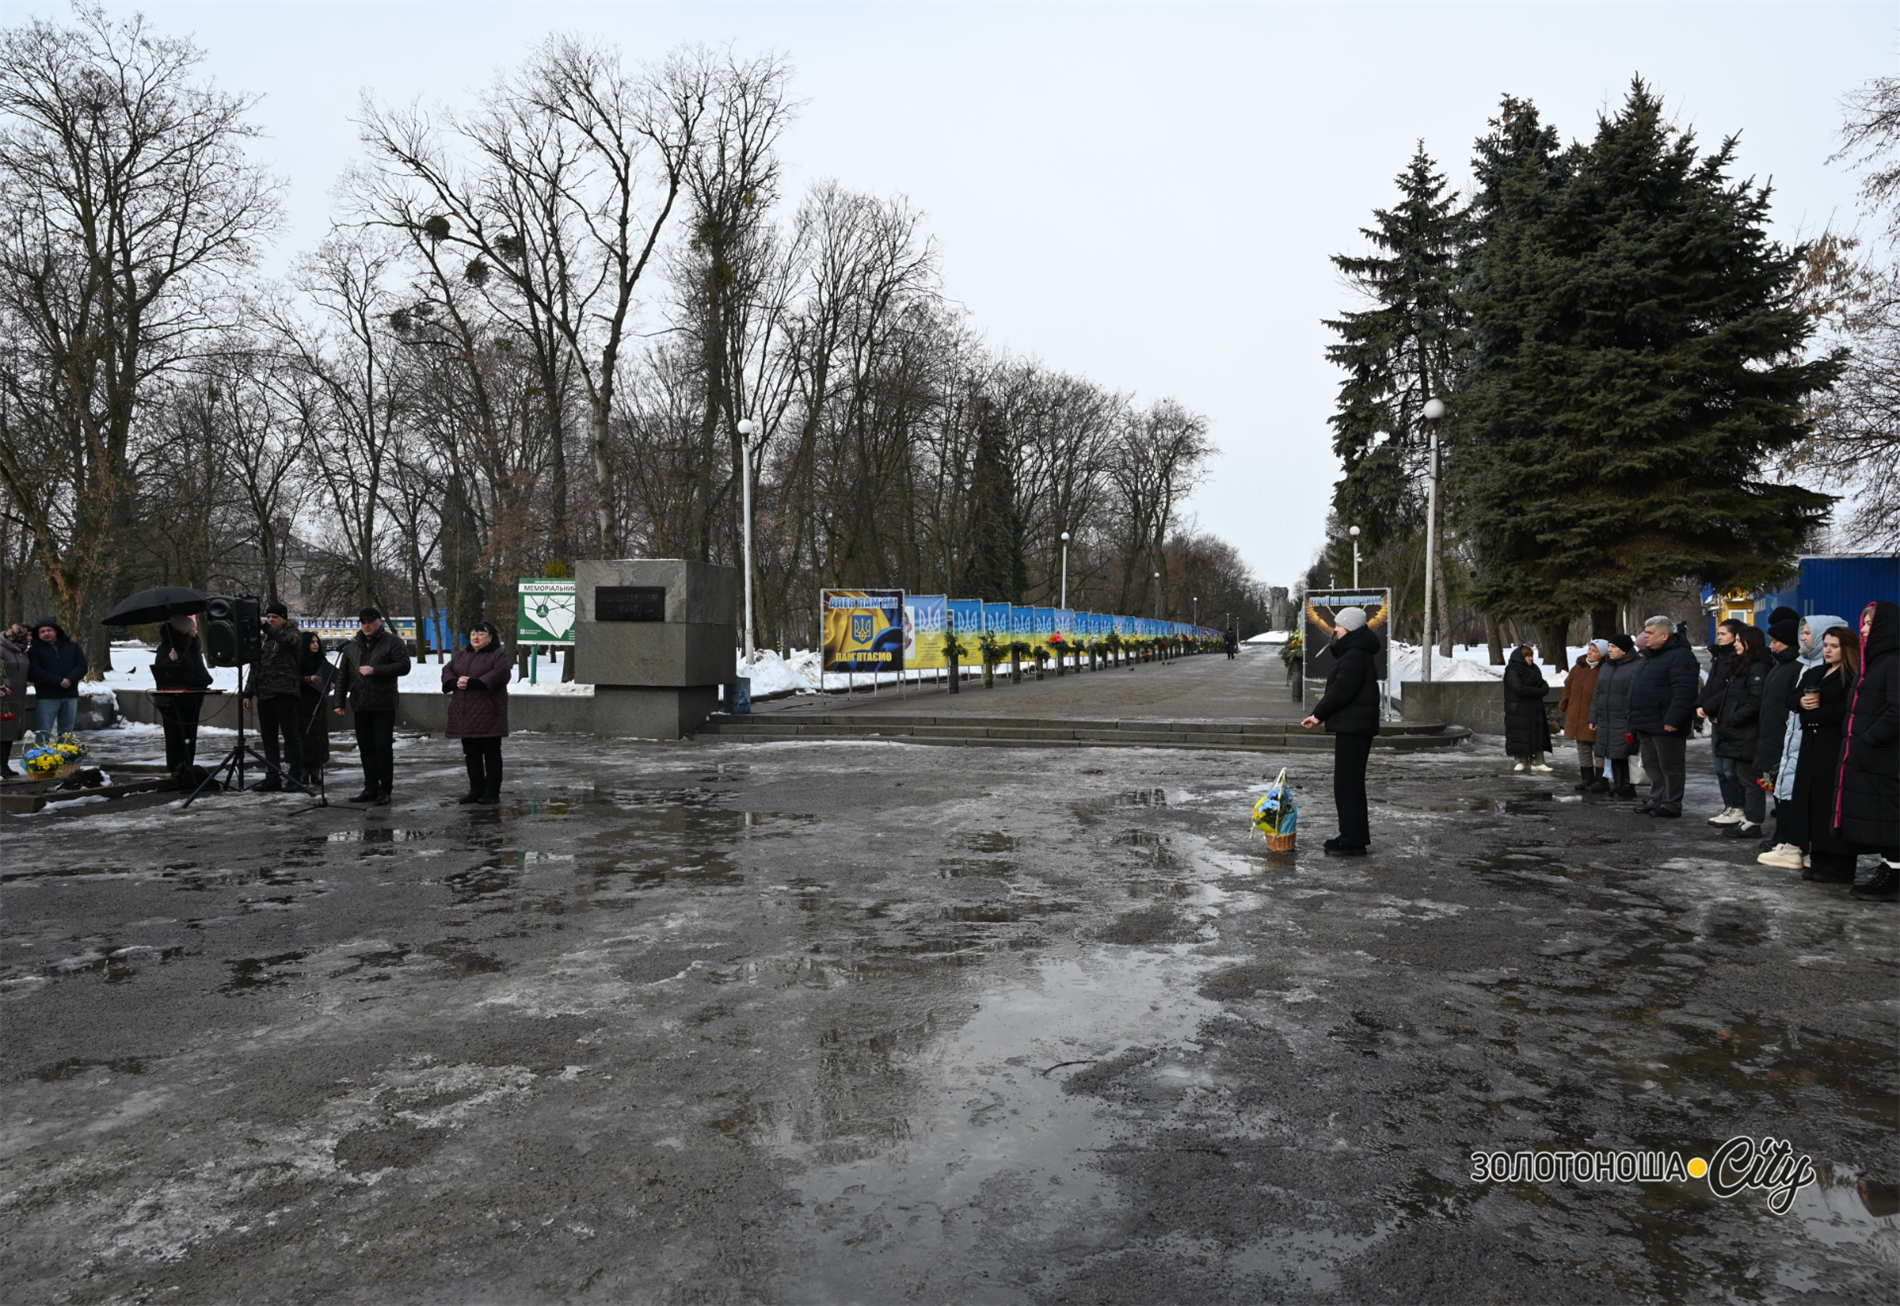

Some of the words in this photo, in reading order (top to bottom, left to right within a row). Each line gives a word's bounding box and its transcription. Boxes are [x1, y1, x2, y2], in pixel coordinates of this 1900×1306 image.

[829, 597, 857, 609] АЛЕЯ
[1309, 595, 1329, 606] ГЕРОЇ
[1330, 596, 1340, 606] НЕ
[1340, 595, 1384, 606] ВМИРАЮТЬ
[836, 652, 893, 662] ПАМ'ЯТАЄМО
